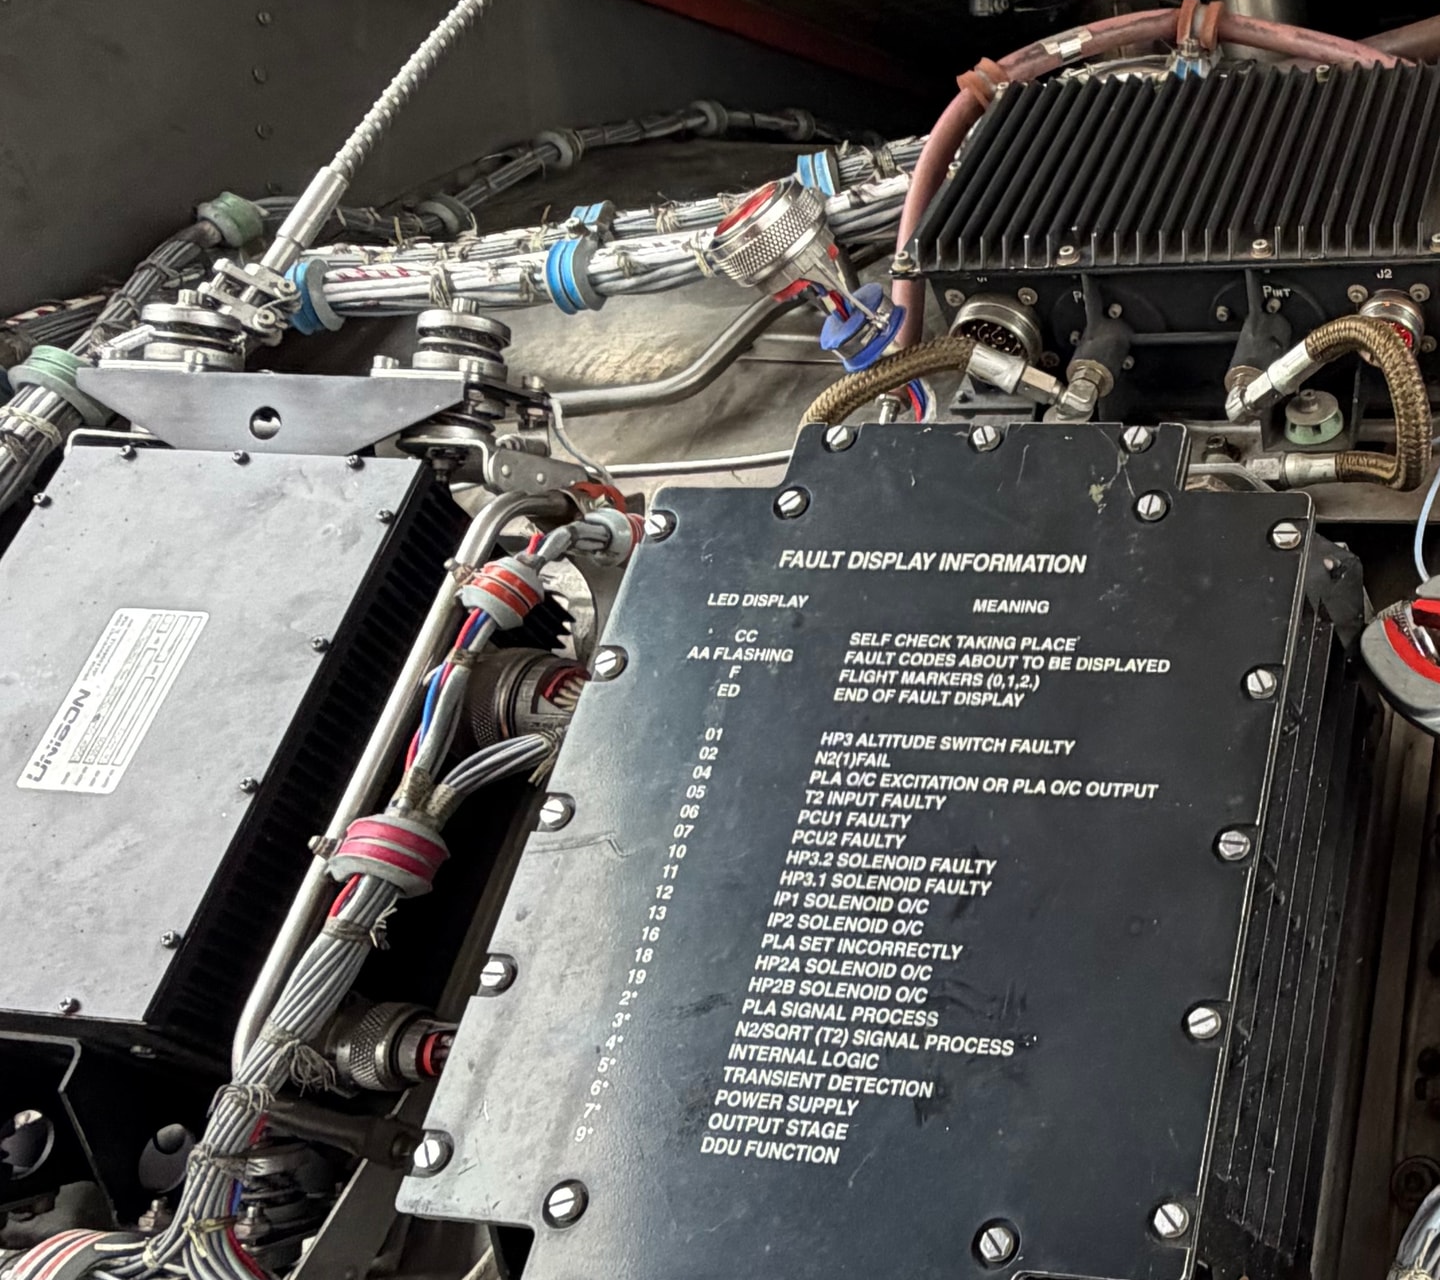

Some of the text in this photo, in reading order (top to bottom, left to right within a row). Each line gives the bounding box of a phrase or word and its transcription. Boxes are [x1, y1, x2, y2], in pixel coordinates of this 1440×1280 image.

[778, 549, 1088, 574] FAULT DISPLAY INFORMATION
[706, 592, 810, 609] LED DISPLAY
[972, 598, 1050, 615] MEANING
[734, 628, 759, 644] CC
[848, 631, 1082, 652] SELF CHECK TAKING PLACE
[686, 645, 794, 665] AA FLASHING
[843, 650, 1171, 674] FAULT CODES ABOUT TO BE DISPLAYED
[728, 664, 742, 680] F
[838, 668, 900, 685] FLIGHT
[900, 670, 984, 687] MARKERS
[716, 682, 741, 698] ED
[832, 687, 1026, 708] END OF FAULT DISPLAY
[704, 726, 724, 742] 01
[819, 731, 1077, 756] HP3 ALTITUDE SWITCH FAULTY
[698, 745, 719, 761] 02
[692, 764, 713, 780] 04
[685, 784, 707, 800] 05
[808, 769, 1160, 800] PLA O/C EXCITATION OR PLA O/C OUTPUT
[804, 788, 948, 811] T2 INPUT FAULTY
[679, 804, 701, 820] 06
[796, 809, 913, 830] PCU1 FAULTY
[673, 823, 695, 839] 07
[791, 828, 908, 850] PCU2 FAULTY
[668, 843, 688, 859] 10
[663, 863, 679, 880] 11
[785, 849, 998, 876] HP3.2 SOLENOID FAULTY
[655, 884, 674, 900] 12
[779, 869, 993, 897] HP3.1 SOLENOID FAULTY
[648, 905, 668, 921] 13
[772, 890, 930, 915] IP1 SOLENOID O/C
[642, 925, 661, 942] 16
[766, 911, 925, 937] IP2 SOLENOID O/C
[635, 947, 654, 964] 18
[760, 932, 964, 961] PLA SET INCORRECTLY
[627, 968, 647, 985] 19
[754, 953, 934, 982] HP2A SOLENOID O/C
[747, 975, 929, 1004] HP2B SOLENOID O/C
[741, 998, 940, 1028] PLA SIGNAL PROCESS
[734, 1020, 1015, 1058] N2/SQRT (T2) SIGNAL PROCESS
[727, 1042, 880, 1071] INTERNAL LOGIC
[723, 1065, 935, 1099] TRANSIENT DETECTION
[714, 1088, 860, 1117] POWER SUPPLY
[707, 1112, 850, 1141] OUTPUT STAGE
[699, 1135, 841, 1165] DDU FUNCTION
